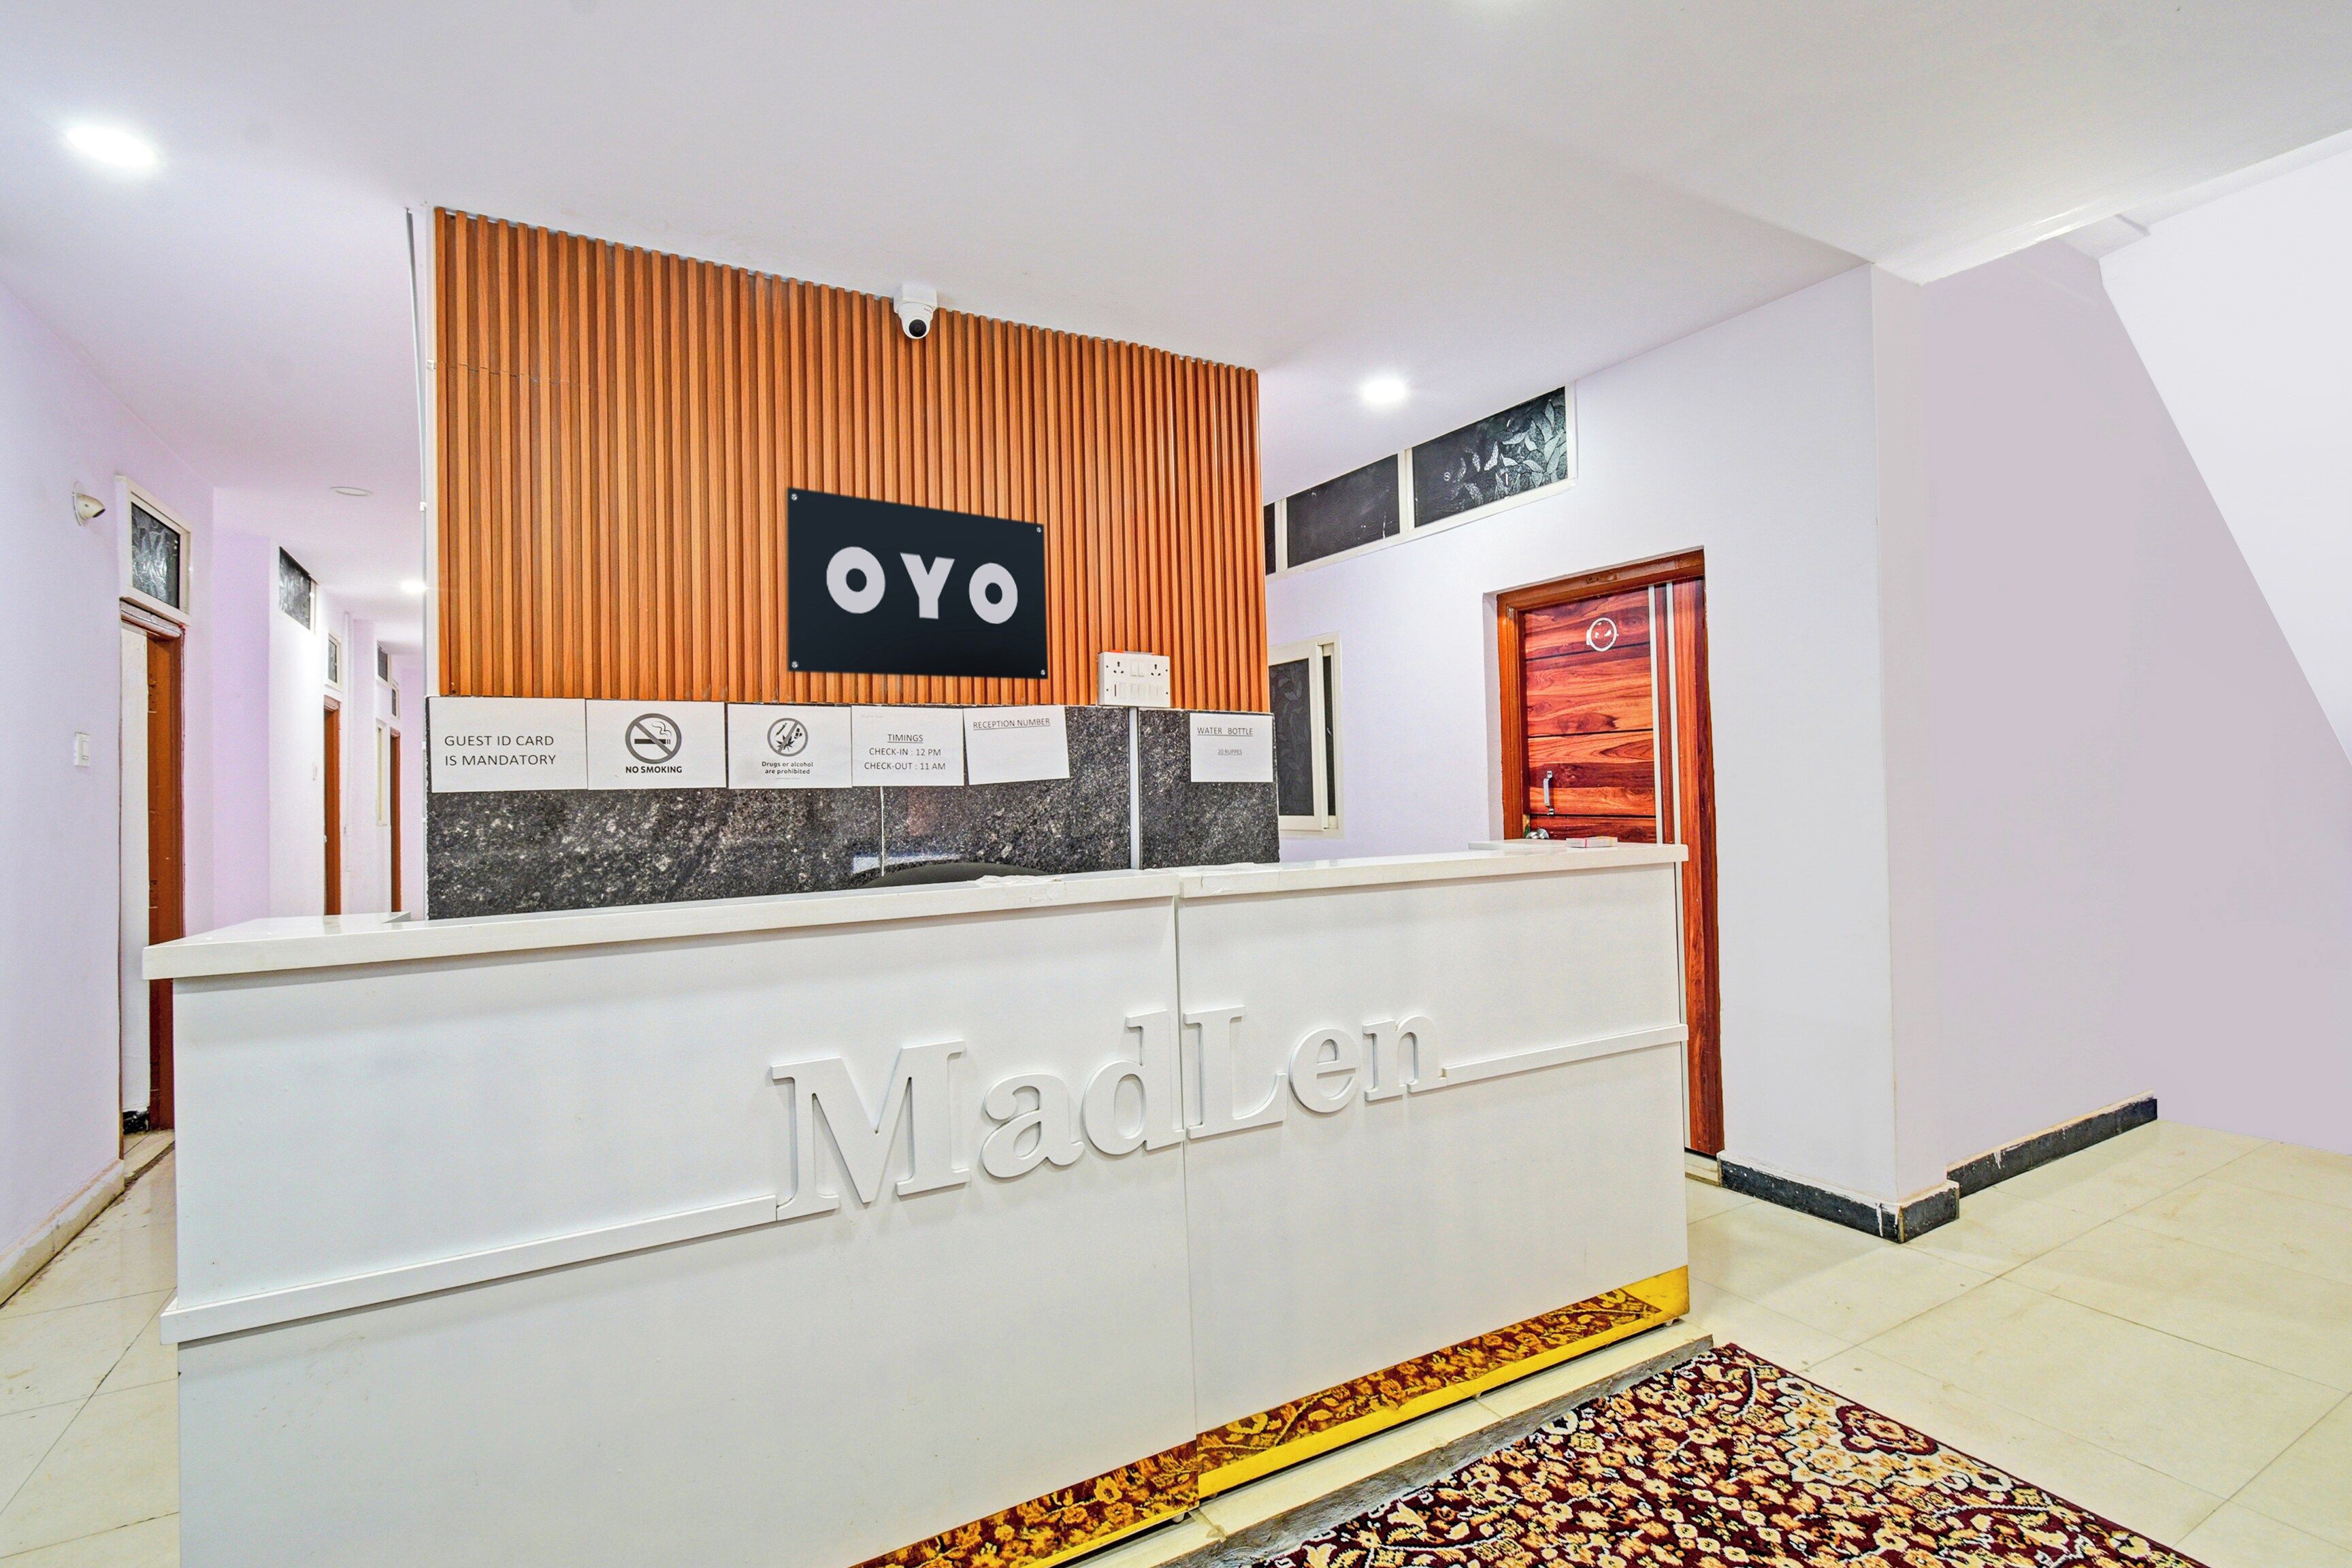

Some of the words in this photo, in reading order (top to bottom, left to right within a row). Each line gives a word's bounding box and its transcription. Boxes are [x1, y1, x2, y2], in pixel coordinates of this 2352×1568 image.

[826, 546, 1018, 624] OYO
[973, 720, 1015, 730] RECEPTION
[1017, 718, 1050, 727] NUMBER
[444, 736, 492, 746] GUEST
[497, 736, 511, 746] ID
[516, 736, 554, 746] CARD
[887, 734, 924, 742] TIMINGS
[869, 747, 909, 756] CHECK-IN
[445, 755, 457, 766] IS
[462, 755, 556, 766] MANDATORY
[864, 762, 913, 770] CHECK-OUT
[921, 762, 929, 770] 11
[932, 762, 946, 770] AM
